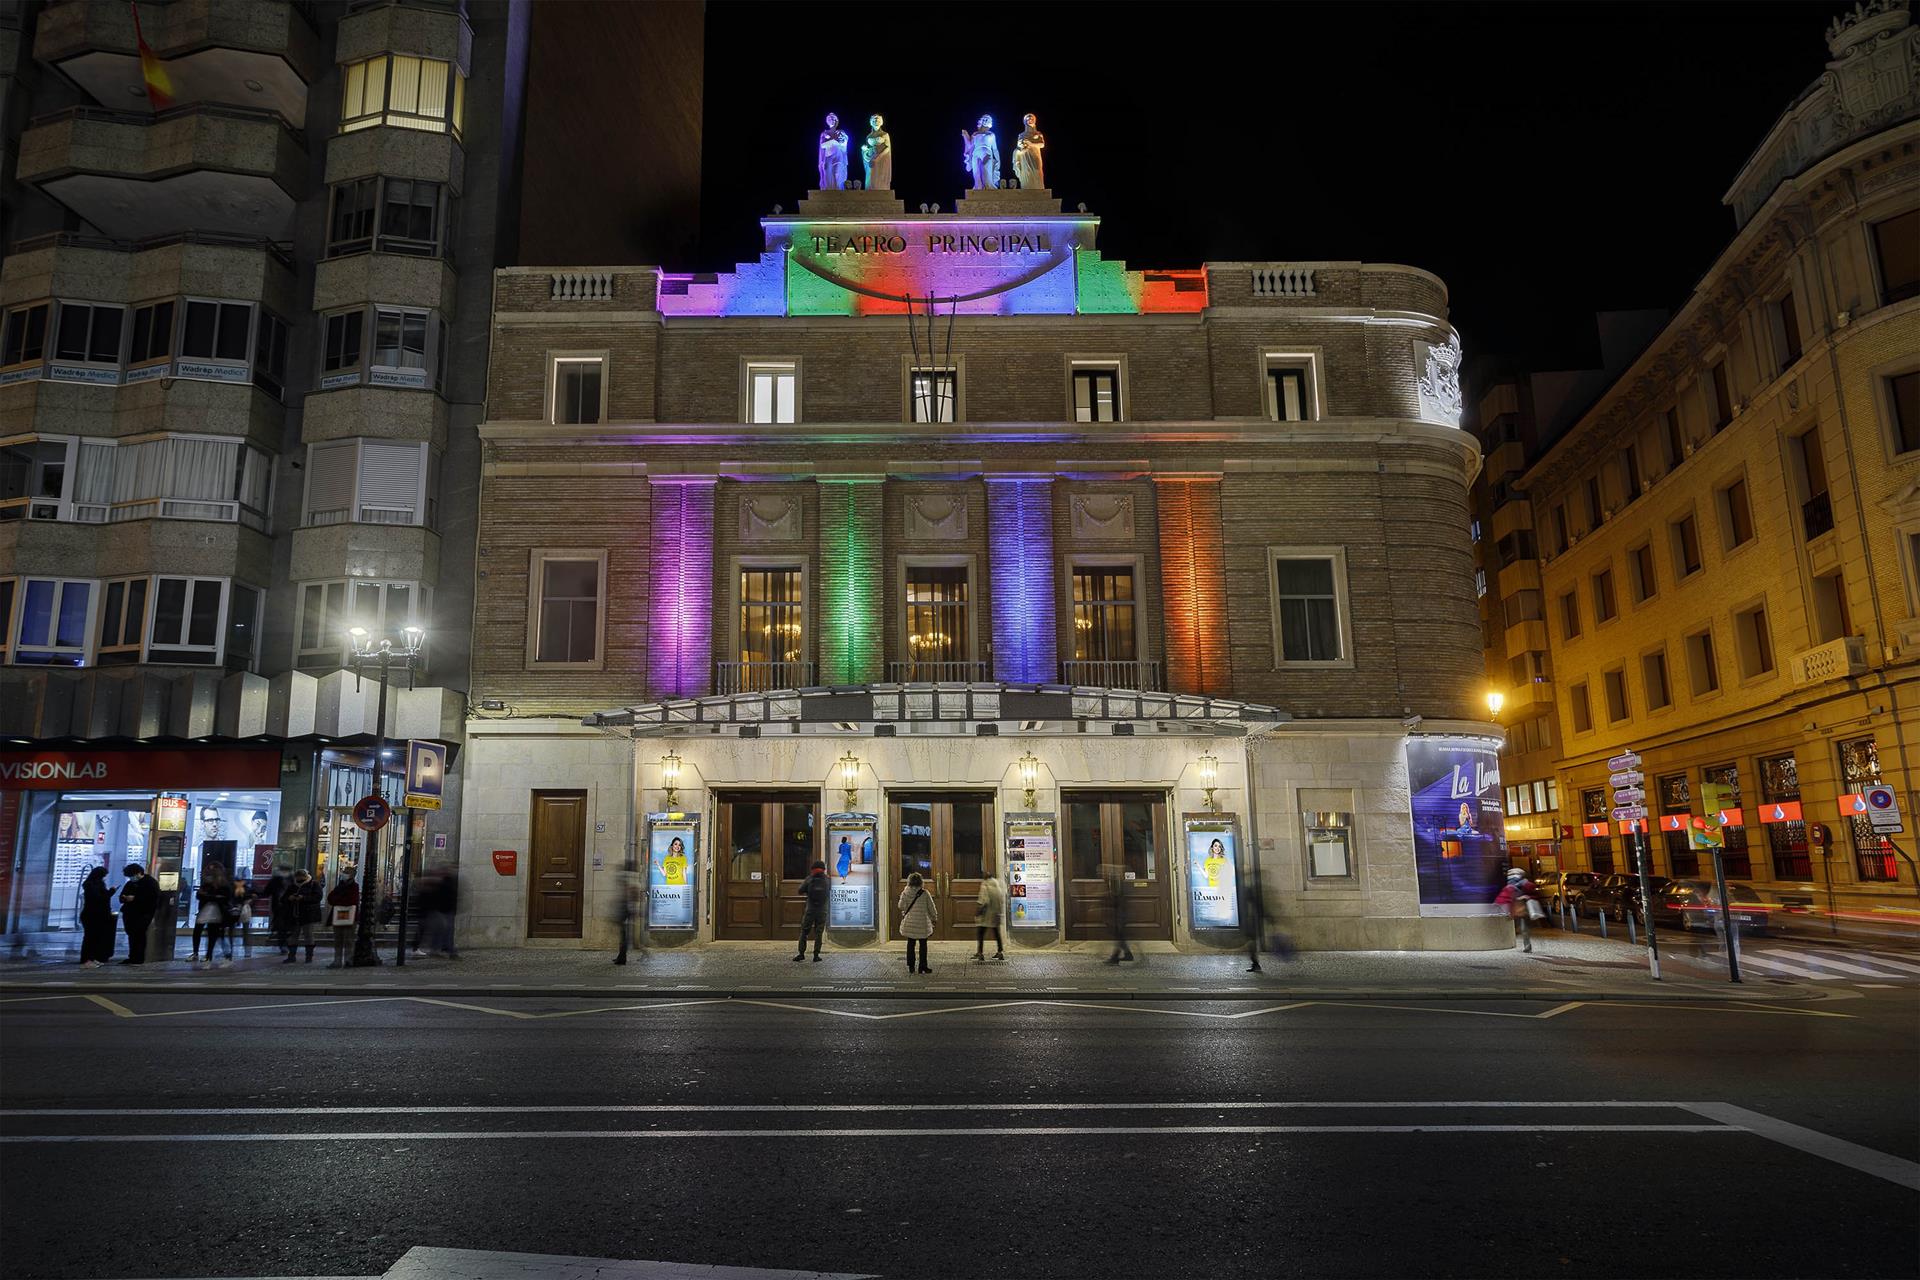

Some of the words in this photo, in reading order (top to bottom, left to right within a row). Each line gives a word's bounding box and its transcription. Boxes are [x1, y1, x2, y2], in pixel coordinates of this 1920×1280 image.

[811, 235, 907, 254] TEATRO
[928, 235, 1052, 254] PRINCIPAL
[87, 371, 117, 379] Medics
[0, 762, 107, 779] VISIONLAB
[415, 748, 440, 788] P
[1451, 764, 1472, 799] La
[162, 799, 179, 807] BUS
